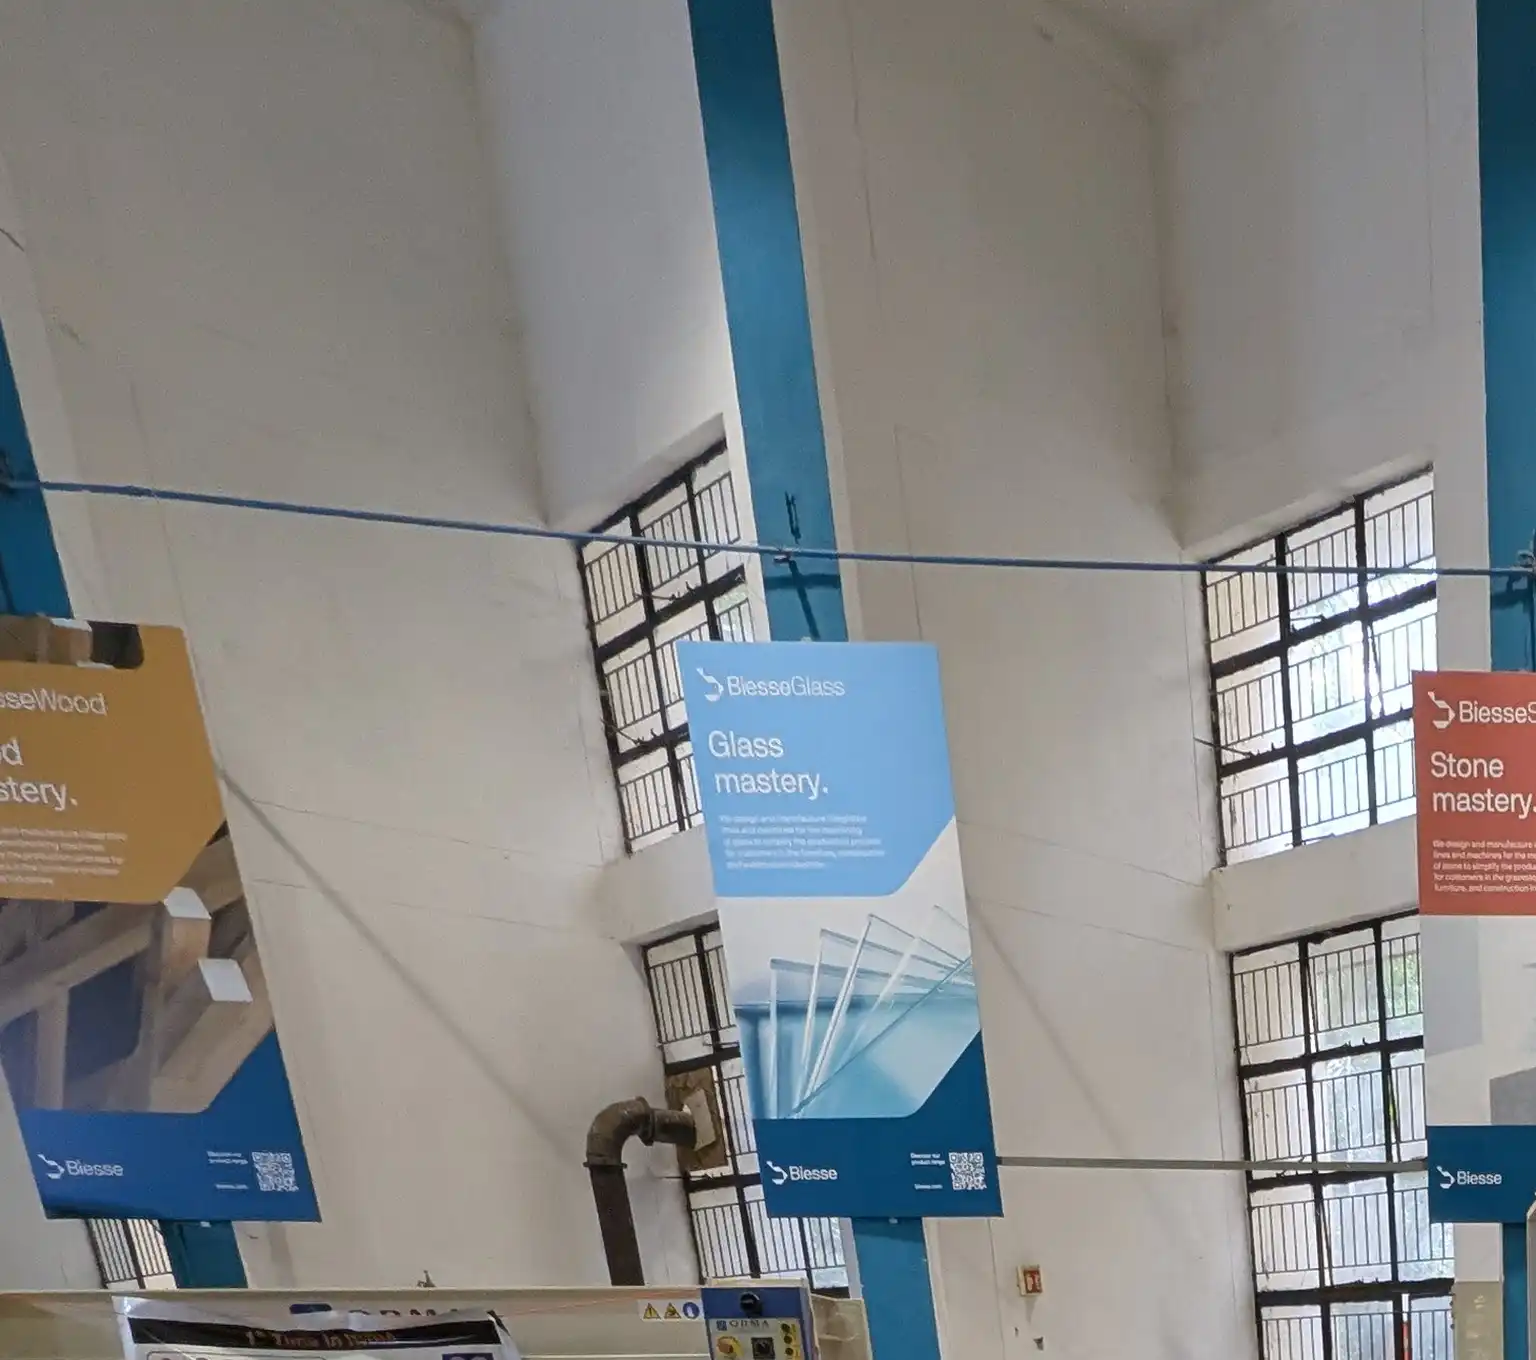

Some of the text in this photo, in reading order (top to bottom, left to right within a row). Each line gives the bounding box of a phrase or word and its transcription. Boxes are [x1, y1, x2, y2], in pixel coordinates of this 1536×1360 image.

[726, 675, 846, 697] BiesseGlass
[708, 730, 784, 758] Glass
[1430, 751, 1504, 778] Stone
[715, 767, 829, 801] mastery.
[65, 1159, 124, 1177] Biesse
[789, 1165, 838, 1181] Biesse
[1456, 1170, 1502, 1186] Biesse
